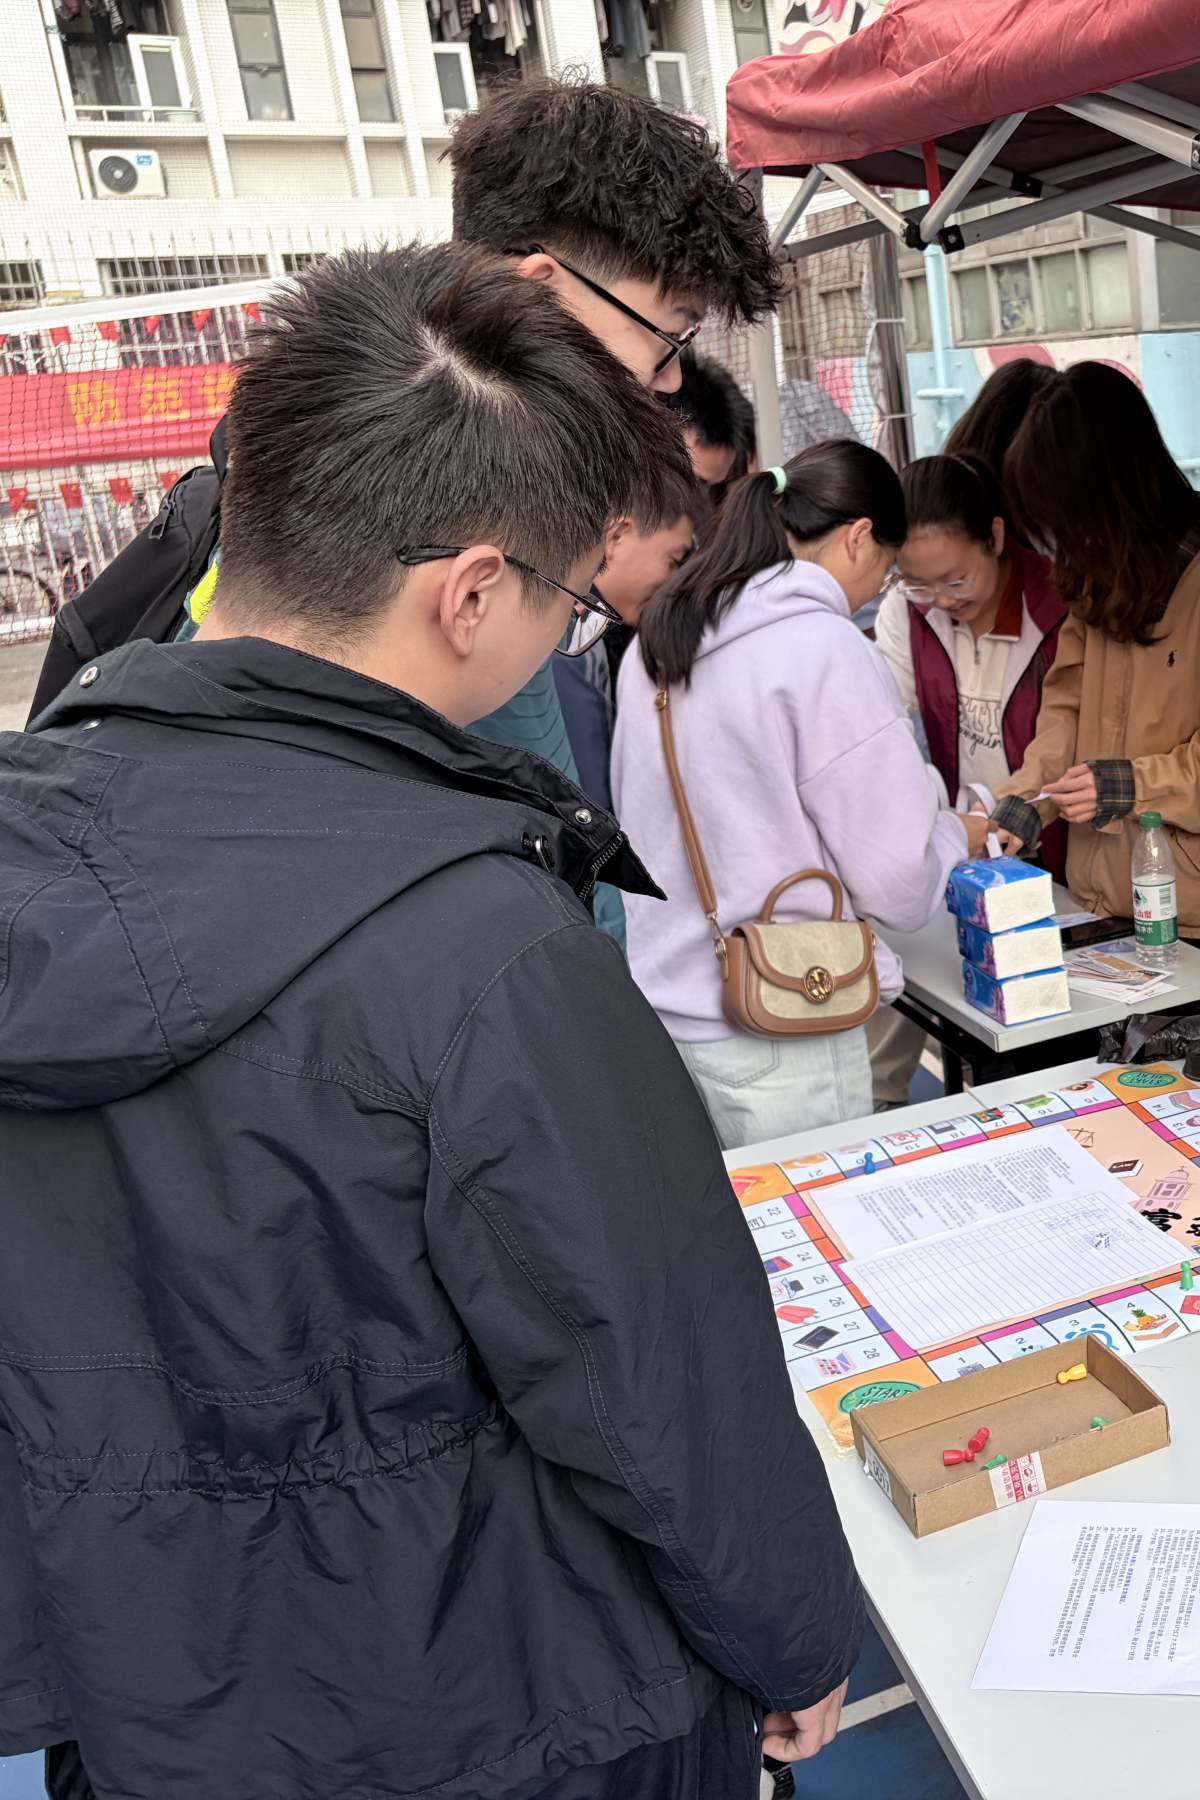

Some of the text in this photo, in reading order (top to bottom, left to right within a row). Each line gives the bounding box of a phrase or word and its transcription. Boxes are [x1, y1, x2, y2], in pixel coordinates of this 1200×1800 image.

[781, 1229, 797, 1240] 23
[813, 1274, 829, 1285] 25
[829, 1297, 845, 1308] 26
[843, 1321, 860, 1332] 27
[863, 1348, 881, 1360] 28
